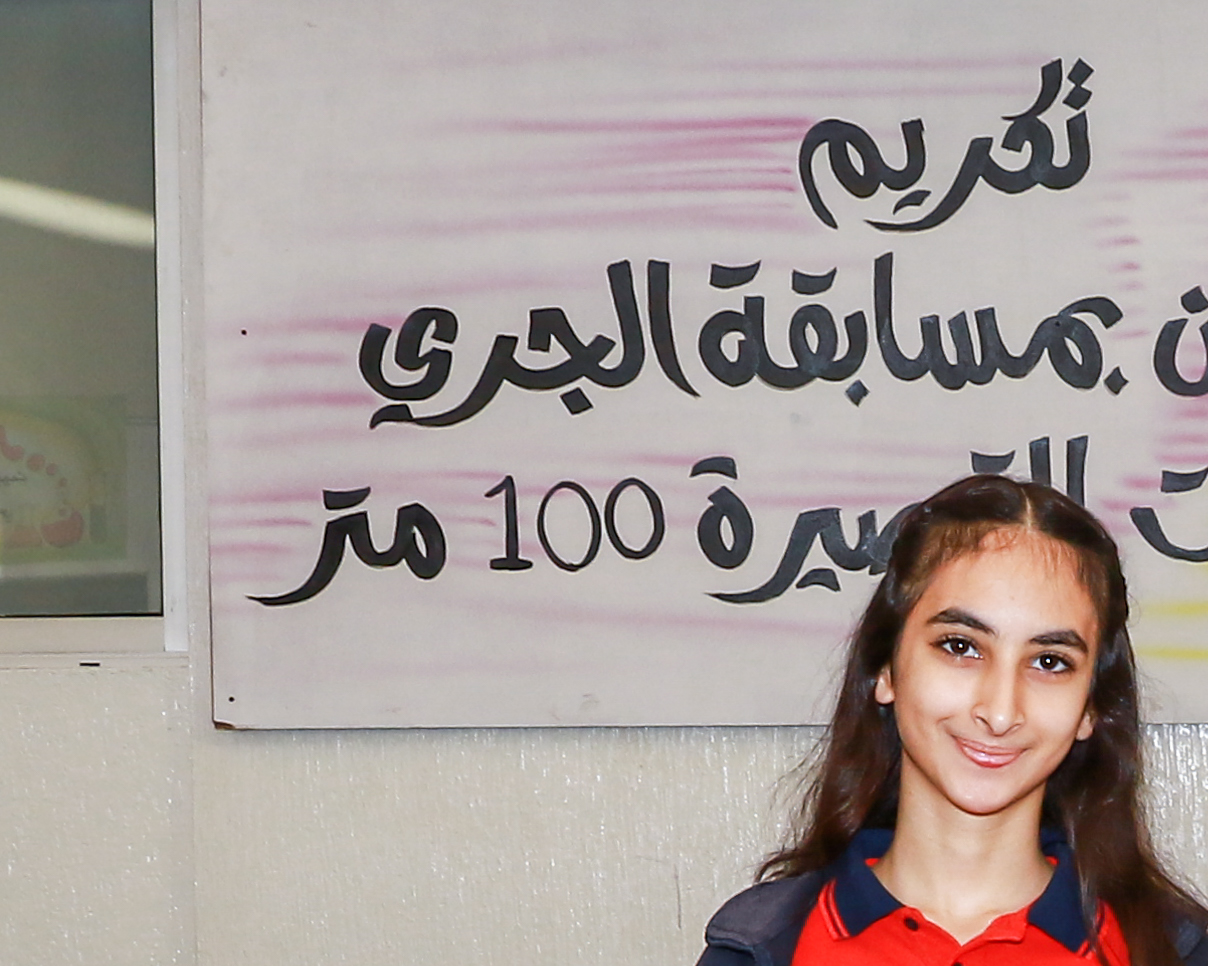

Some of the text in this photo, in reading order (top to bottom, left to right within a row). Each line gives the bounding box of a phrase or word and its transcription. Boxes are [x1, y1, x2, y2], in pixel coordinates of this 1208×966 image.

[799, 58, 1094, 232] تكريم
[358, 259, 700, 430] الجري
[698, 252, 1128, 407] بمسابقة
[246, 486, 446, 606] متر
[485, 478, 665, 572] 100
